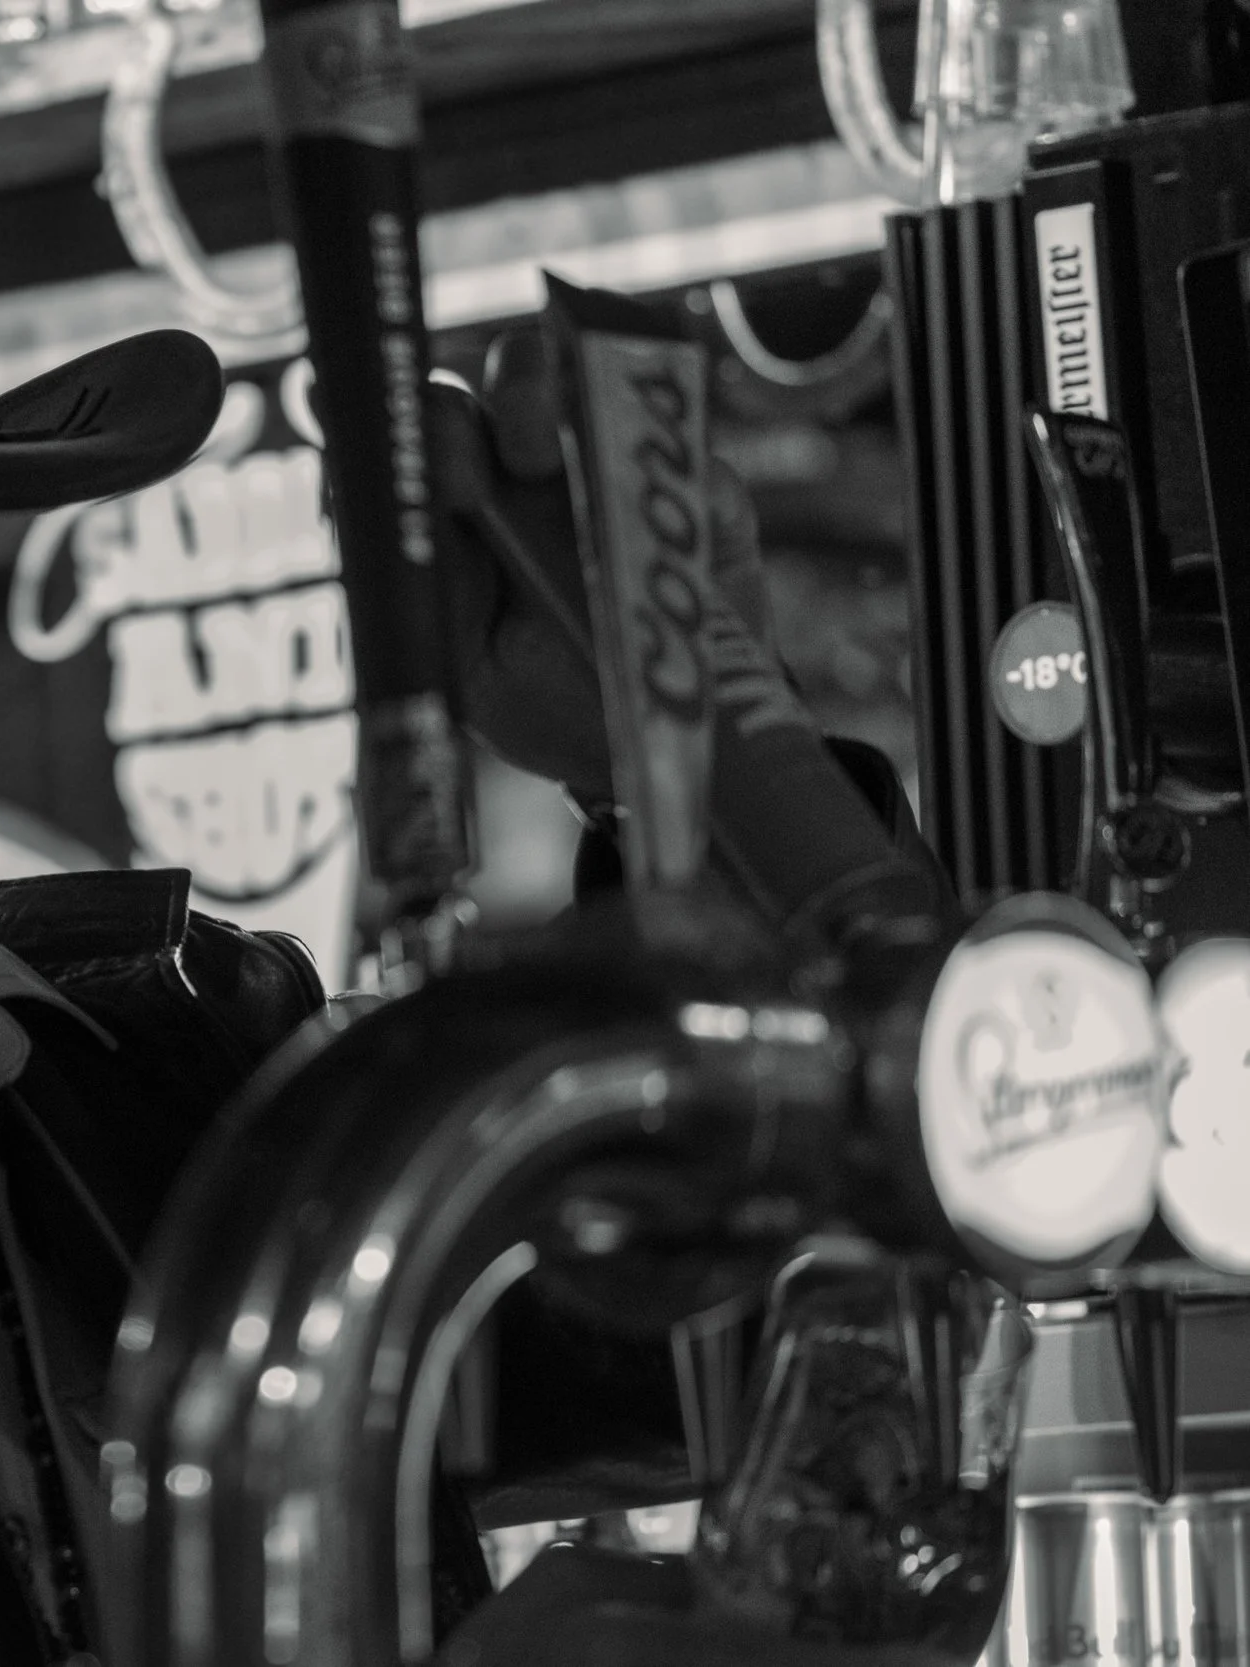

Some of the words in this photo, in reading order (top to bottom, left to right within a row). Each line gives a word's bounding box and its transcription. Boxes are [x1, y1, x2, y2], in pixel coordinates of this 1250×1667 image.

[1049, 244, 1095, 418] rmeister
[628, 371, 702, 727] Coors
[1005, 651, 1088, 691] -18°C
